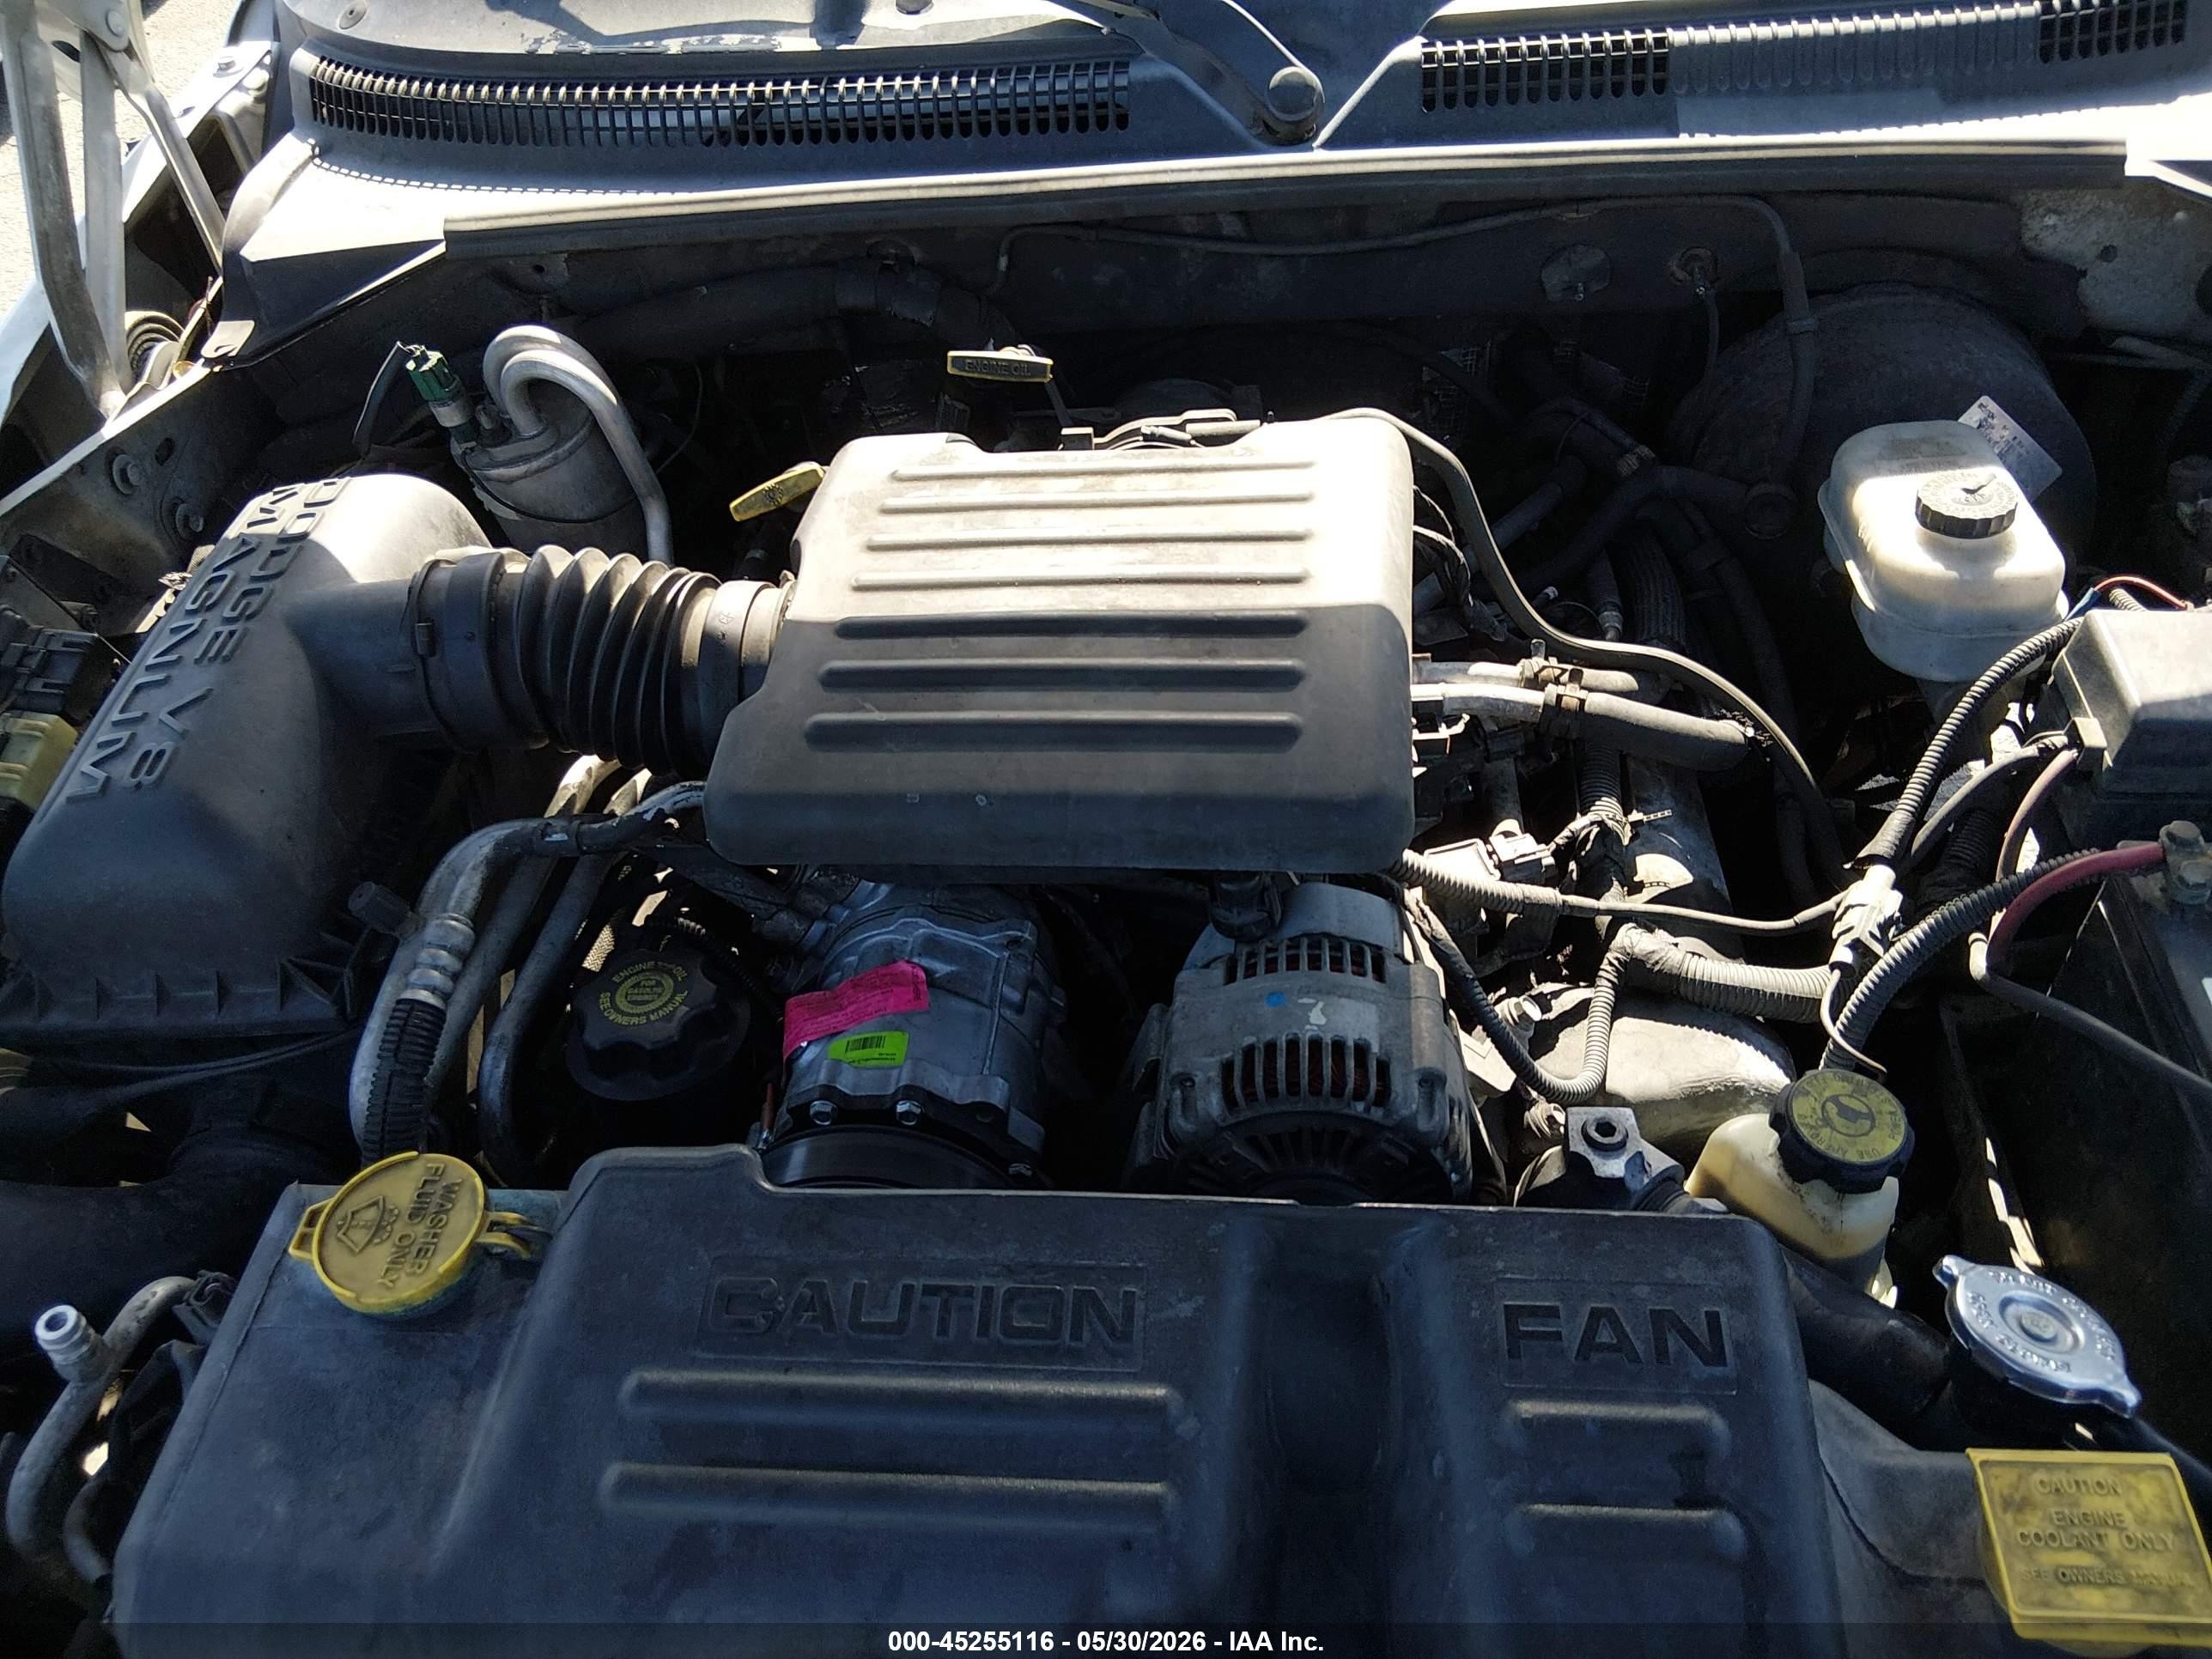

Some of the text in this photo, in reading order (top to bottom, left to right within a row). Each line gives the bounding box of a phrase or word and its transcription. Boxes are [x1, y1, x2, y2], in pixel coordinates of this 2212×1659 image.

[964, 359, 1031, 376] ENGINE OIL
[66, 483, 305, 804] MAGNUM
[129, 477, 353, 789] DODGE V8
[611, 961, 689, 983] ENGINE OIL
[599, 989, 689, 1025] SEE OWNERS MANUAL
[377, 1163, 446, 1289] FLUID ONLY
[412, 1177, 463, 1276] WASHER
[710, 1276, 1729, 1368] CAUTION FAN
[2036, 1476, 2123, 1497] CAUTION
[2051, 1510, 2127, 1528] ENGINE
[2016, 1530, 2175, 1551] COOLANT ONLY
[2056, 1567, 2126, 1585] OWNERS
